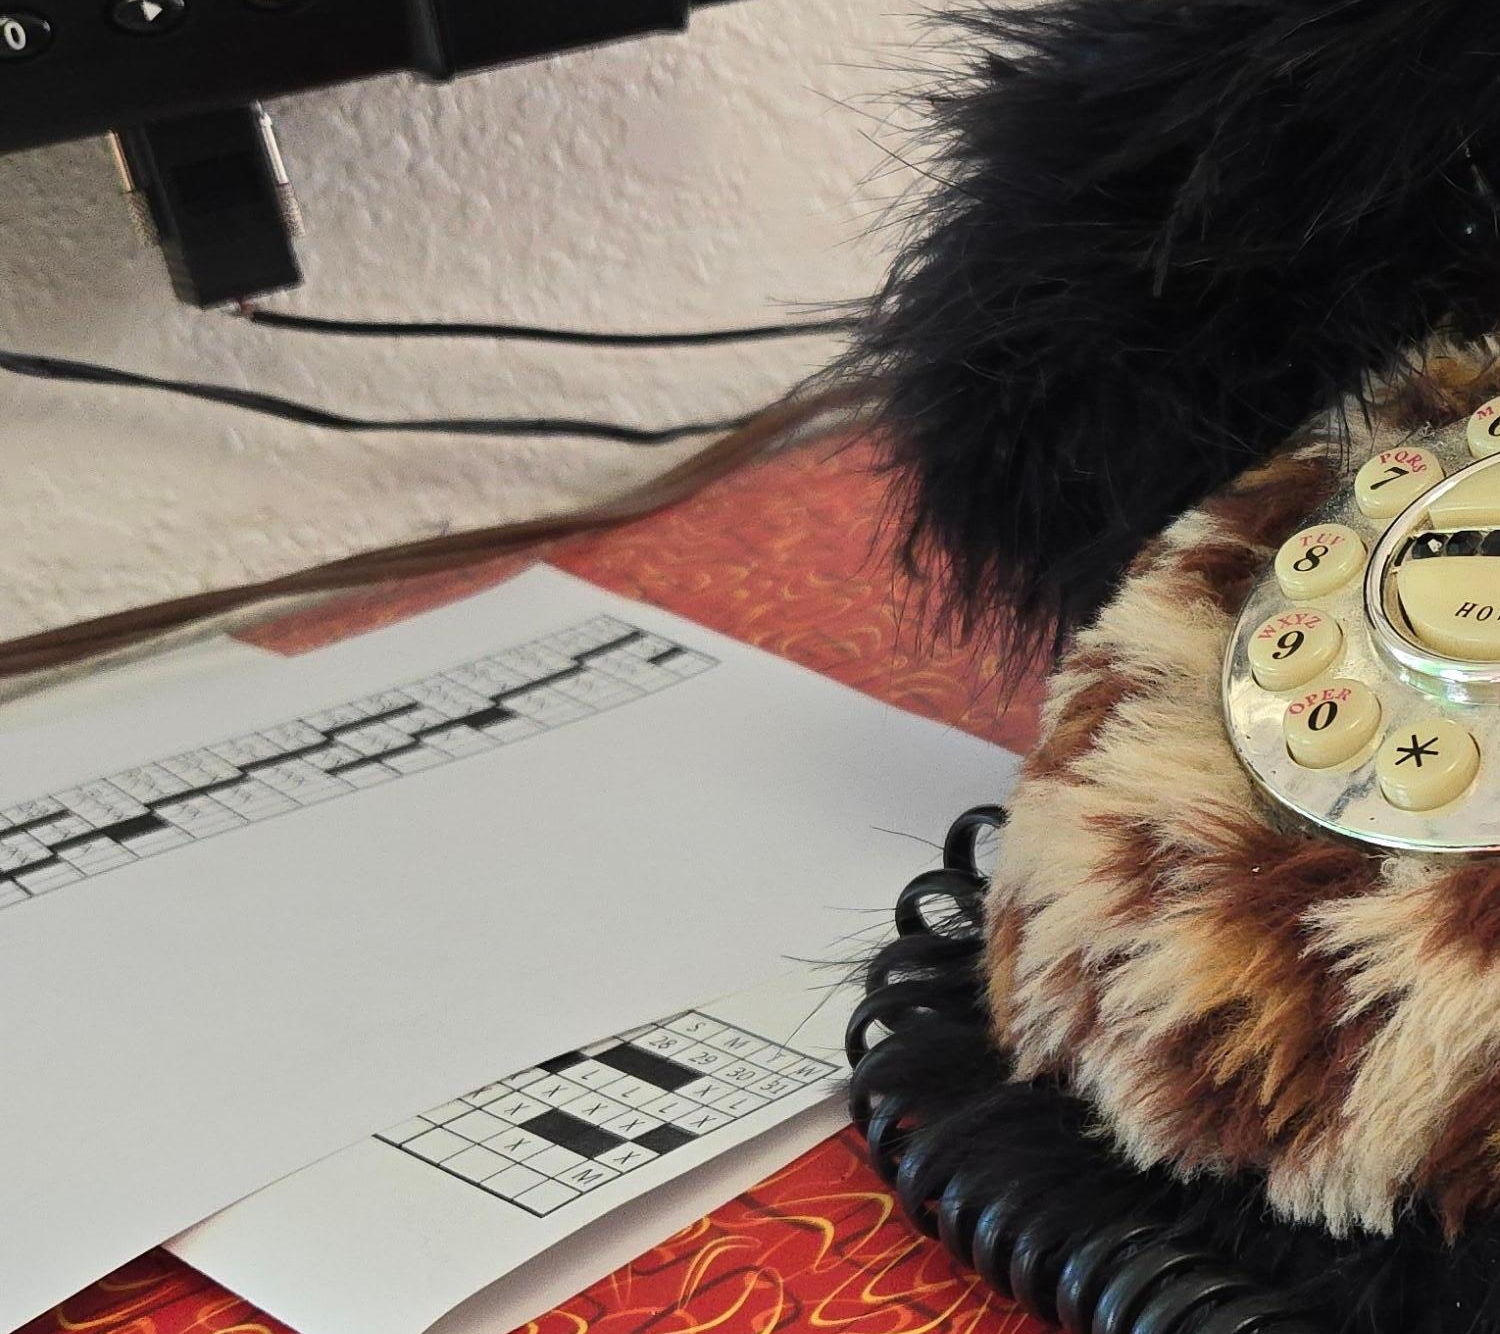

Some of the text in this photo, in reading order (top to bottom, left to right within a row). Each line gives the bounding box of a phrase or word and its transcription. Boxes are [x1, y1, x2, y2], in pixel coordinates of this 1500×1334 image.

[1378, 450, 1428, 474] PQRS
[1370, 466, 1410, 490] 7
[1300, 533, 1347, 548] TUV
[1293, 544, 1329, 572] 8
[1257, 613, 1322, 642] WXYZ
[1272, 630, 1305, 660] 9
[1288, 687, 1353, 716] OPER
[1307, 700, 1338, 731] 0
[649, 1035, 782, 1095] 28 29 30 31
